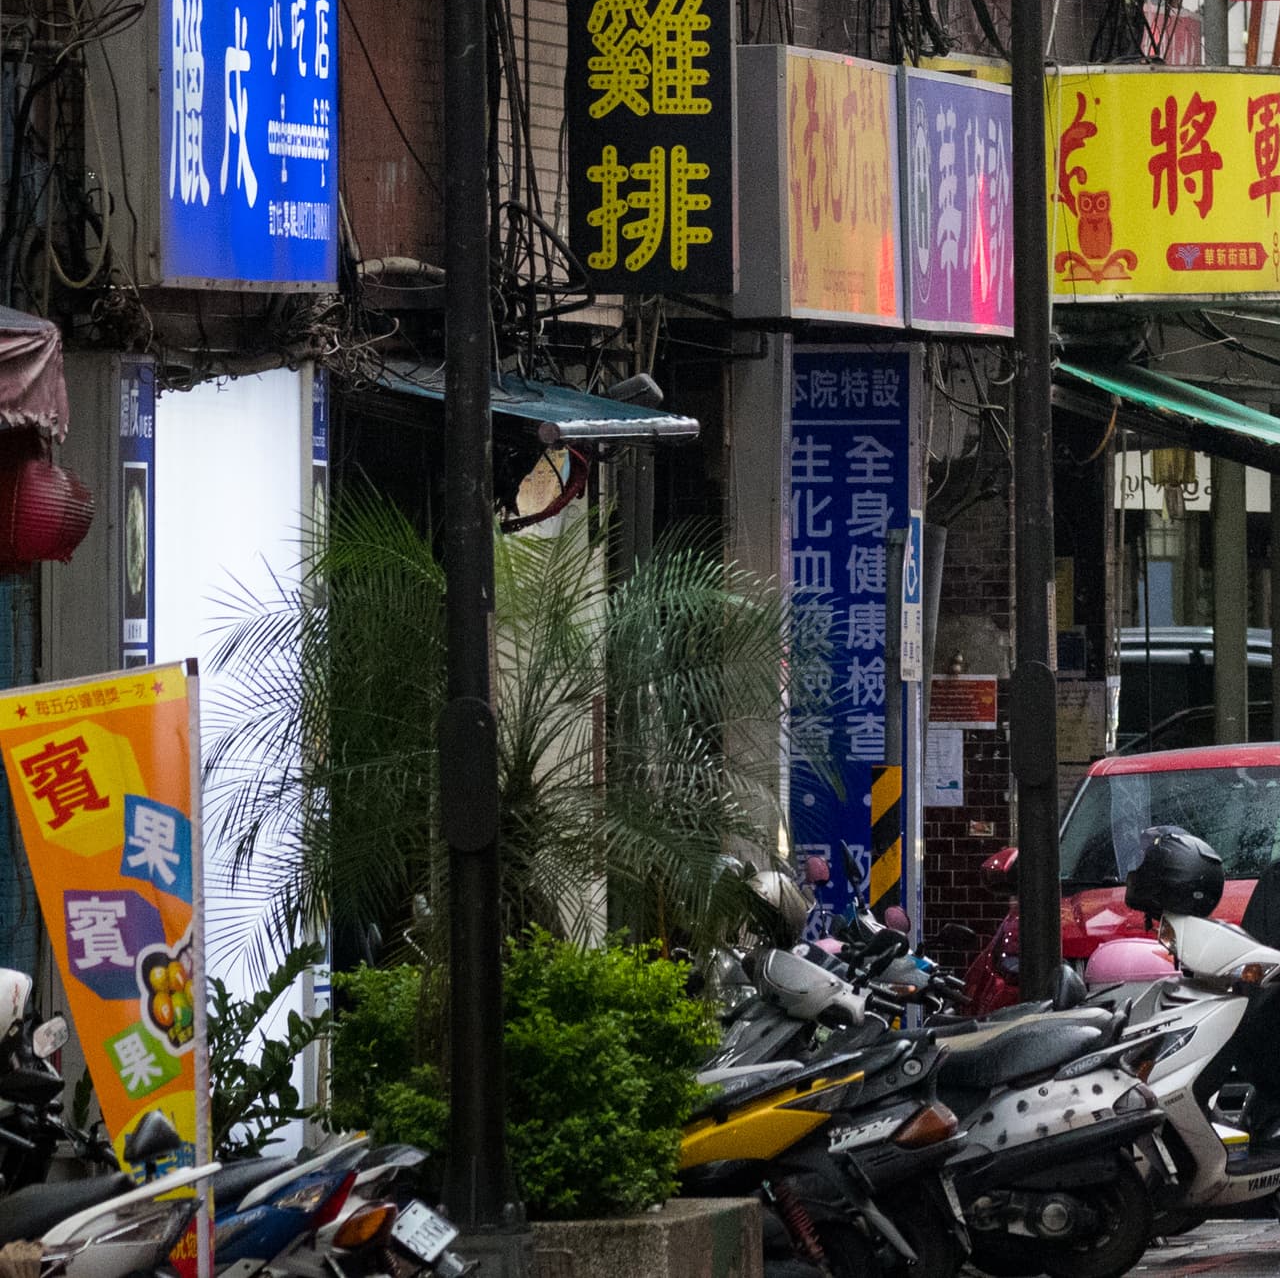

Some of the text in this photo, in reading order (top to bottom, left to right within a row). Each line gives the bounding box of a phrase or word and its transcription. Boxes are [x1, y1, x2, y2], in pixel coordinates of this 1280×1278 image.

[846, 435, 894, 763] 全身健康檢查
